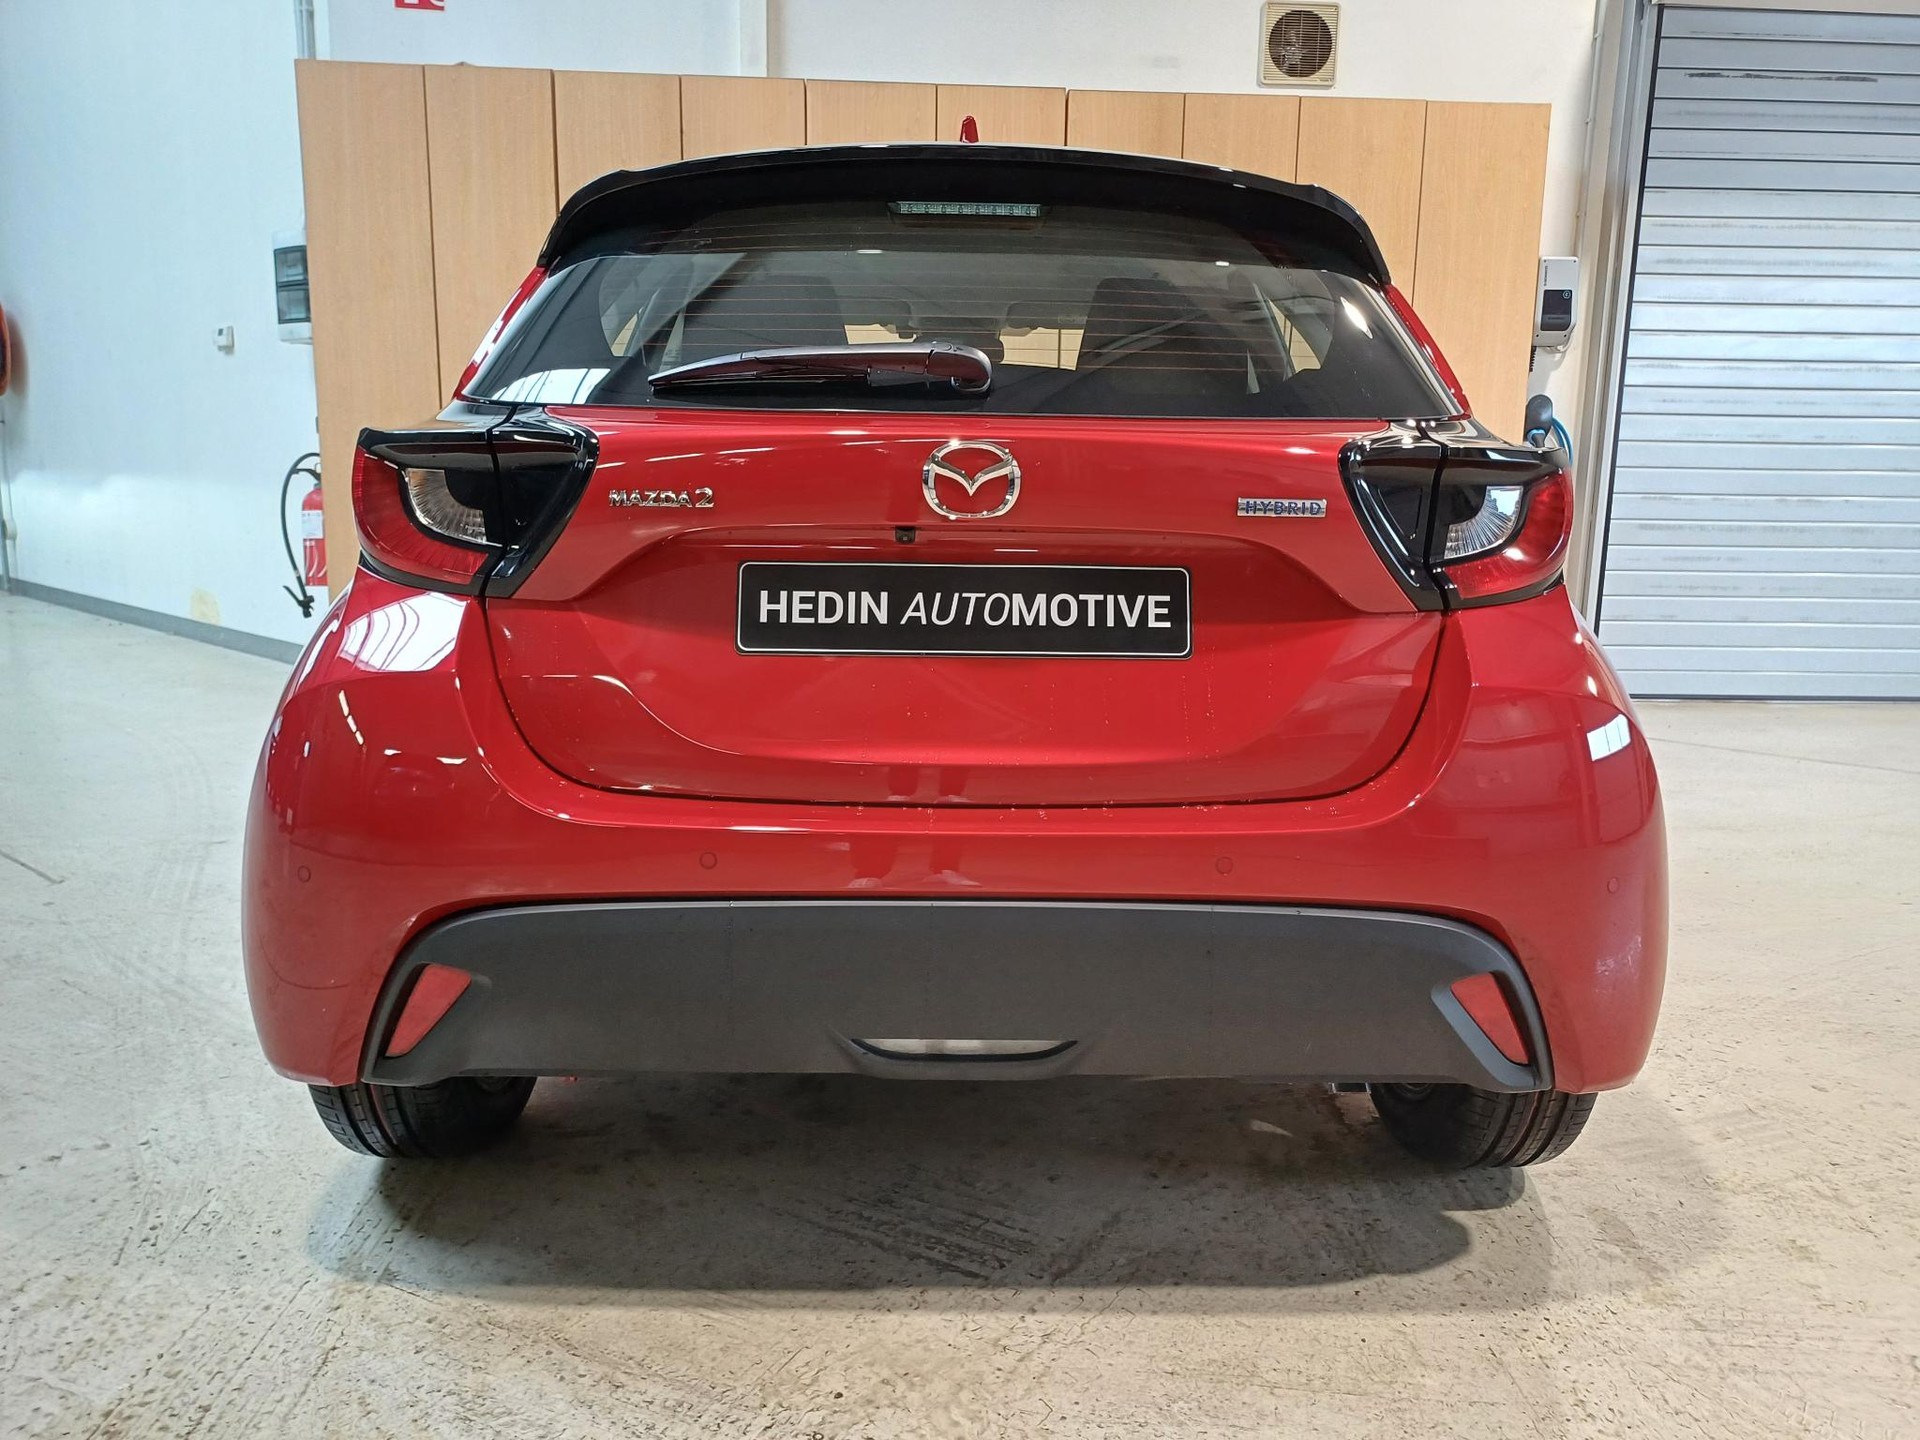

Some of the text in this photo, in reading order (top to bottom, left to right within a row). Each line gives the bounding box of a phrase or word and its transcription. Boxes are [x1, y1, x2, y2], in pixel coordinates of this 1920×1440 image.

[1245, 500, 1322, 516] HYBRID
[759, 590, 1172, 628] HEDIN AUTOMOTIVE
